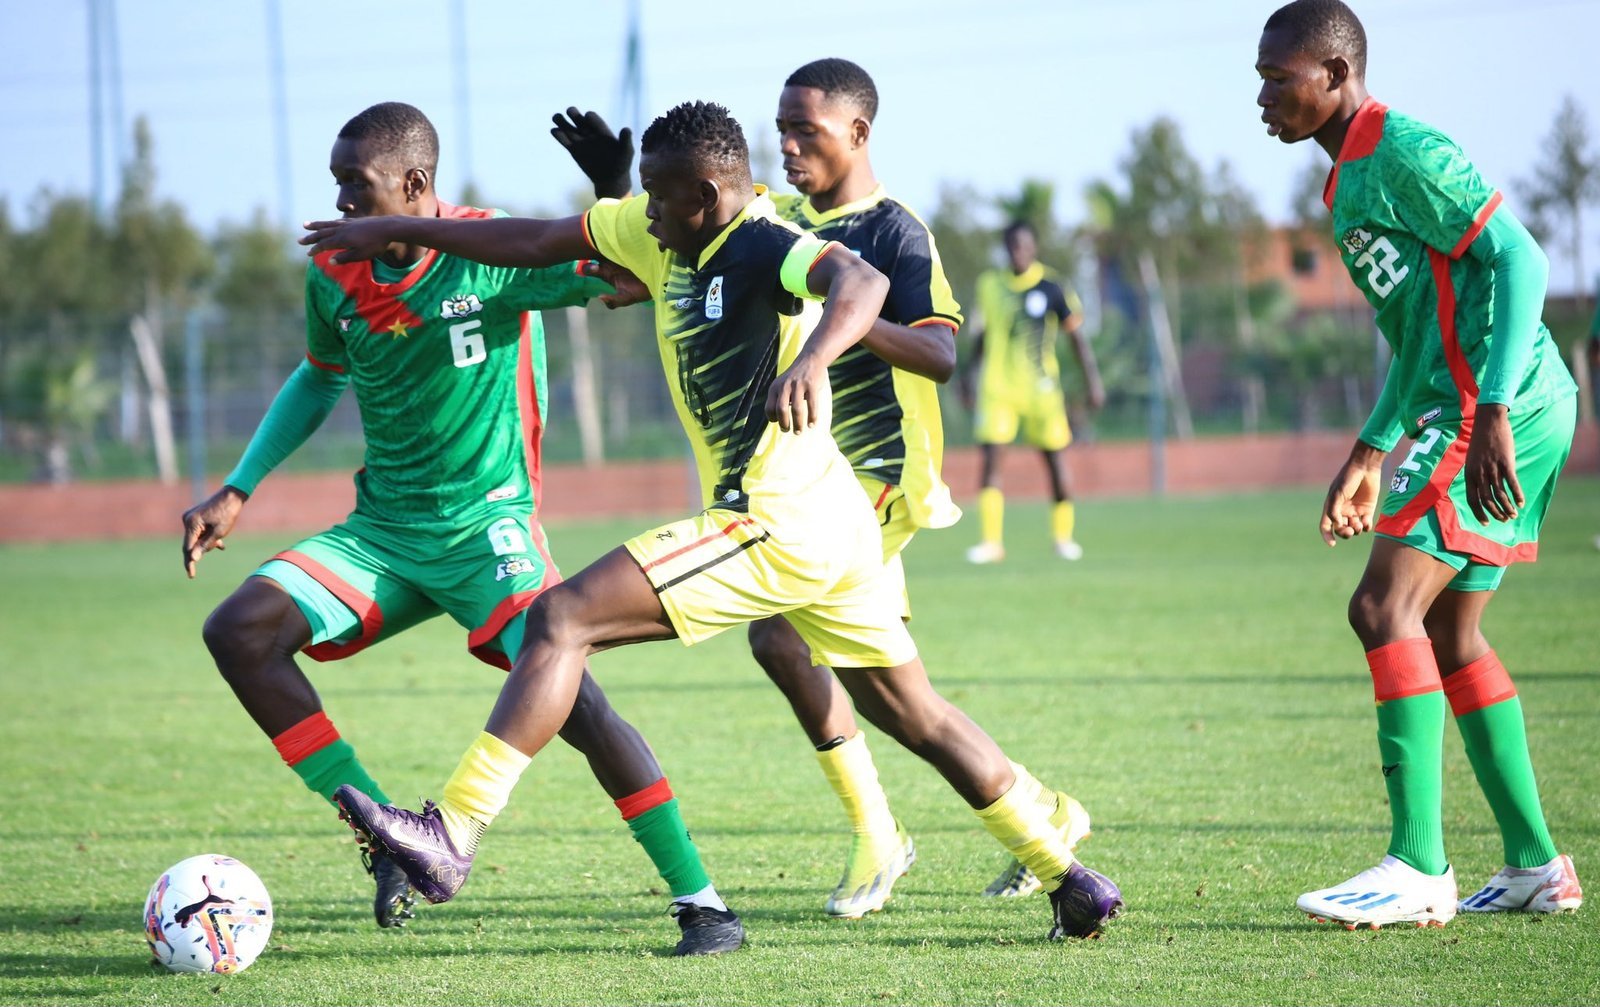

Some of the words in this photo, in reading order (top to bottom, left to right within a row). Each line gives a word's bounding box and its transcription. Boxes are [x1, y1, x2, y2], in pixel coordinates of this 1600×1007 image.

[1354, 235, 1409, 299] 22
[449, 319, 487, 368] 6
[1400, 428, 1442, 471] 2
[487, 517, 528, 556] 6
